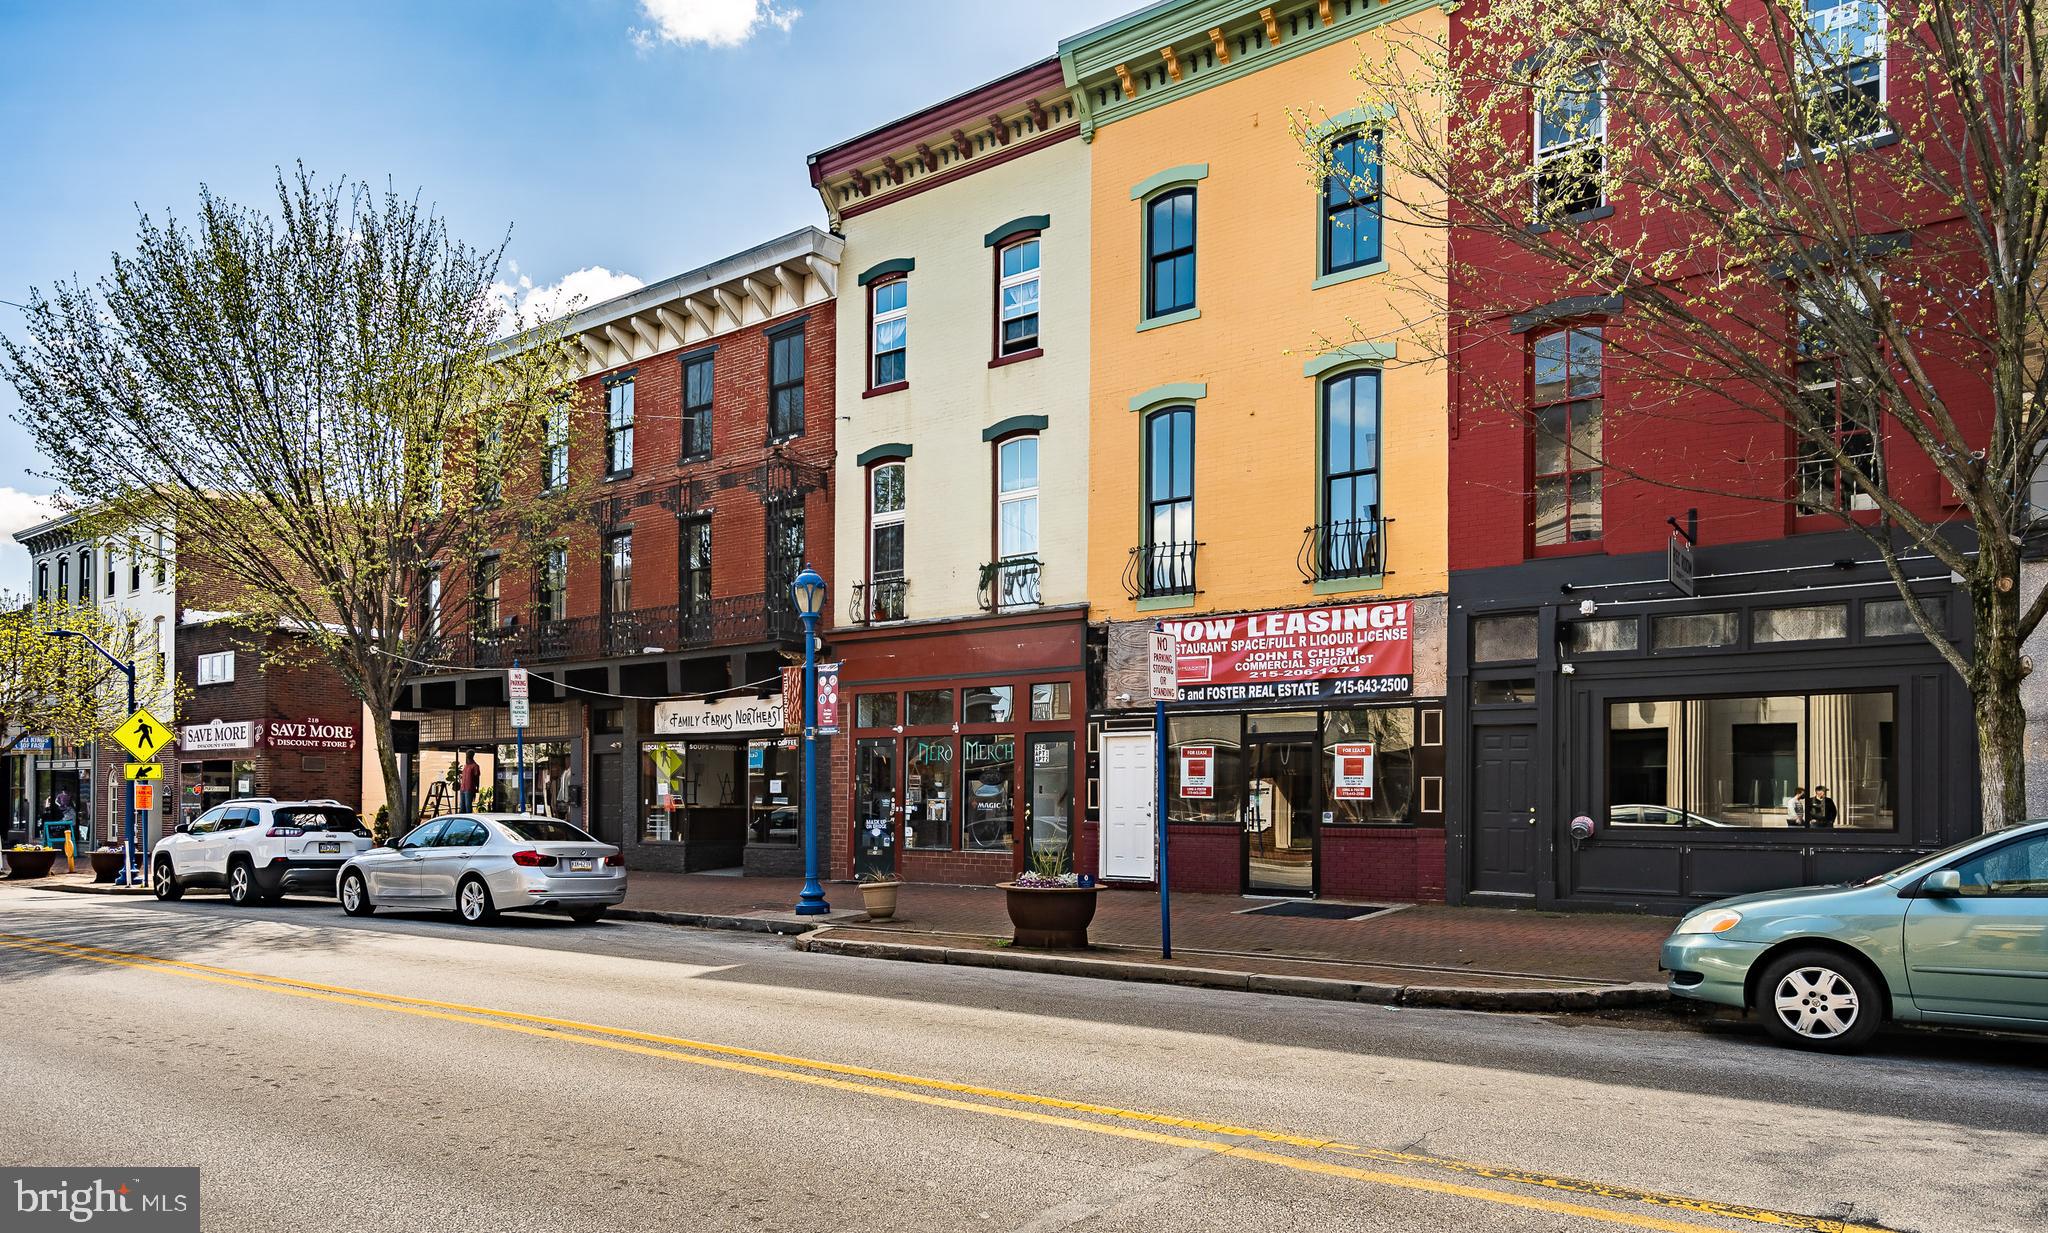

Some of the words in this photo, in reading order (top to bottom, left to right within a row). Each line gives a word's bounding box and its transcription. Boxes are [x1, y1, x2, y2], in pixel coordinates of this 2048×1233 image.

[1164, 619, 1235, 642] NOW
[1248, 604, 1407, 638] LEASING!
[1156, 637, 1167, 651] NO
[1176, 641, 1228, 654] STAURANT
[1231, 636, 1296, 652] SPACE/FULL
[1299, 636, 1306, 647] R
[1310, 632, 1354, 646] LIQOUR
[1358, 628, 1408, 642] LICENSE
[1154, 653, 1172, 664] PARKING
[1245, 652, 1288, 662] JOHN
[1293, 650, 1302, 659] R
[1308, 646, 1358, 658] CHISM
[1153, 664, 1174, 674] STOPPING
[1235, 660, 1306, 671] COMMERCIAL
[1309, 654, 1374, 667] SPECIALIST
[1249, 666, 1360, 678] 215-206-1474
[1160, 676, 1166, 686] OR
[1188, 688, 1204, 700] and
[1207, 685, 1246, 700] FOSTER
[1248, 683, 1276, 698] REAL
[1278, 682, 1320, 697] ESTATE
[1334, 677, 1408, 694] 215-643-2500
[1153, 687, 1174, 698] STANDING
[670, 713, 700, 727] FAMILY
[702, 712, 732, 730] FARMS
[736, 706, 784, 727] NORTHEAST
[188, 728, 212, 742] SAVE
[214, 726, 246, 742] MORE
[270, 723, 306, 736] SAVE
[310, 724, 354, 738] MORE
[777, 738, 797, 746] COFFEE
[966, 741, 1014, 764] MERCH
